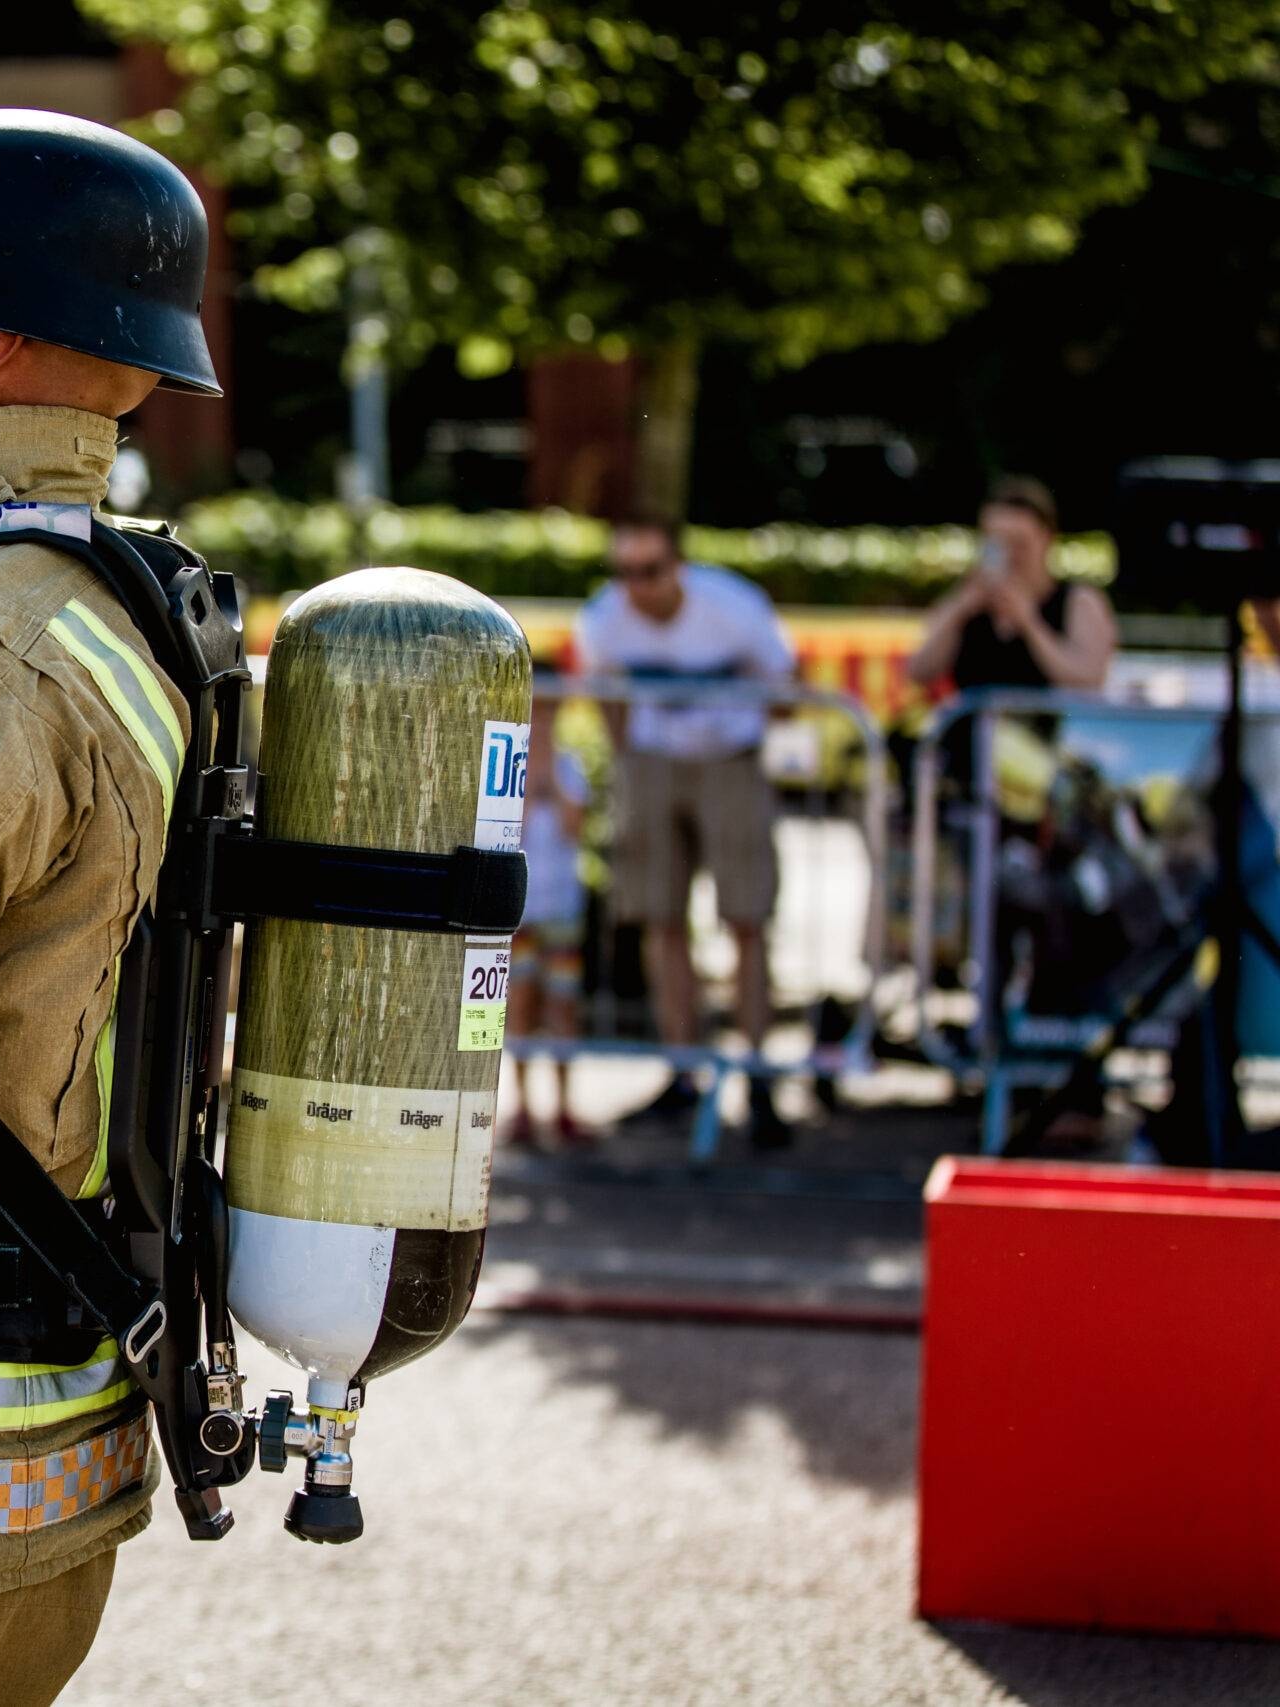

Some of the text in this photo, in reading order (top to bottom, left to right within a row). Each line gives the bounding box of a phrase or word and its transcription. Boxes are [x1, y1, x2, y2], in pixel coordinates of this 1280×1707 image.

[469, 967, 509, 1000] 207
[241, 1090, 269, 1112] Dräger
[306, 1101, 354, 1123] Dräger
[399, 1109, 444, 1130] Dräger
